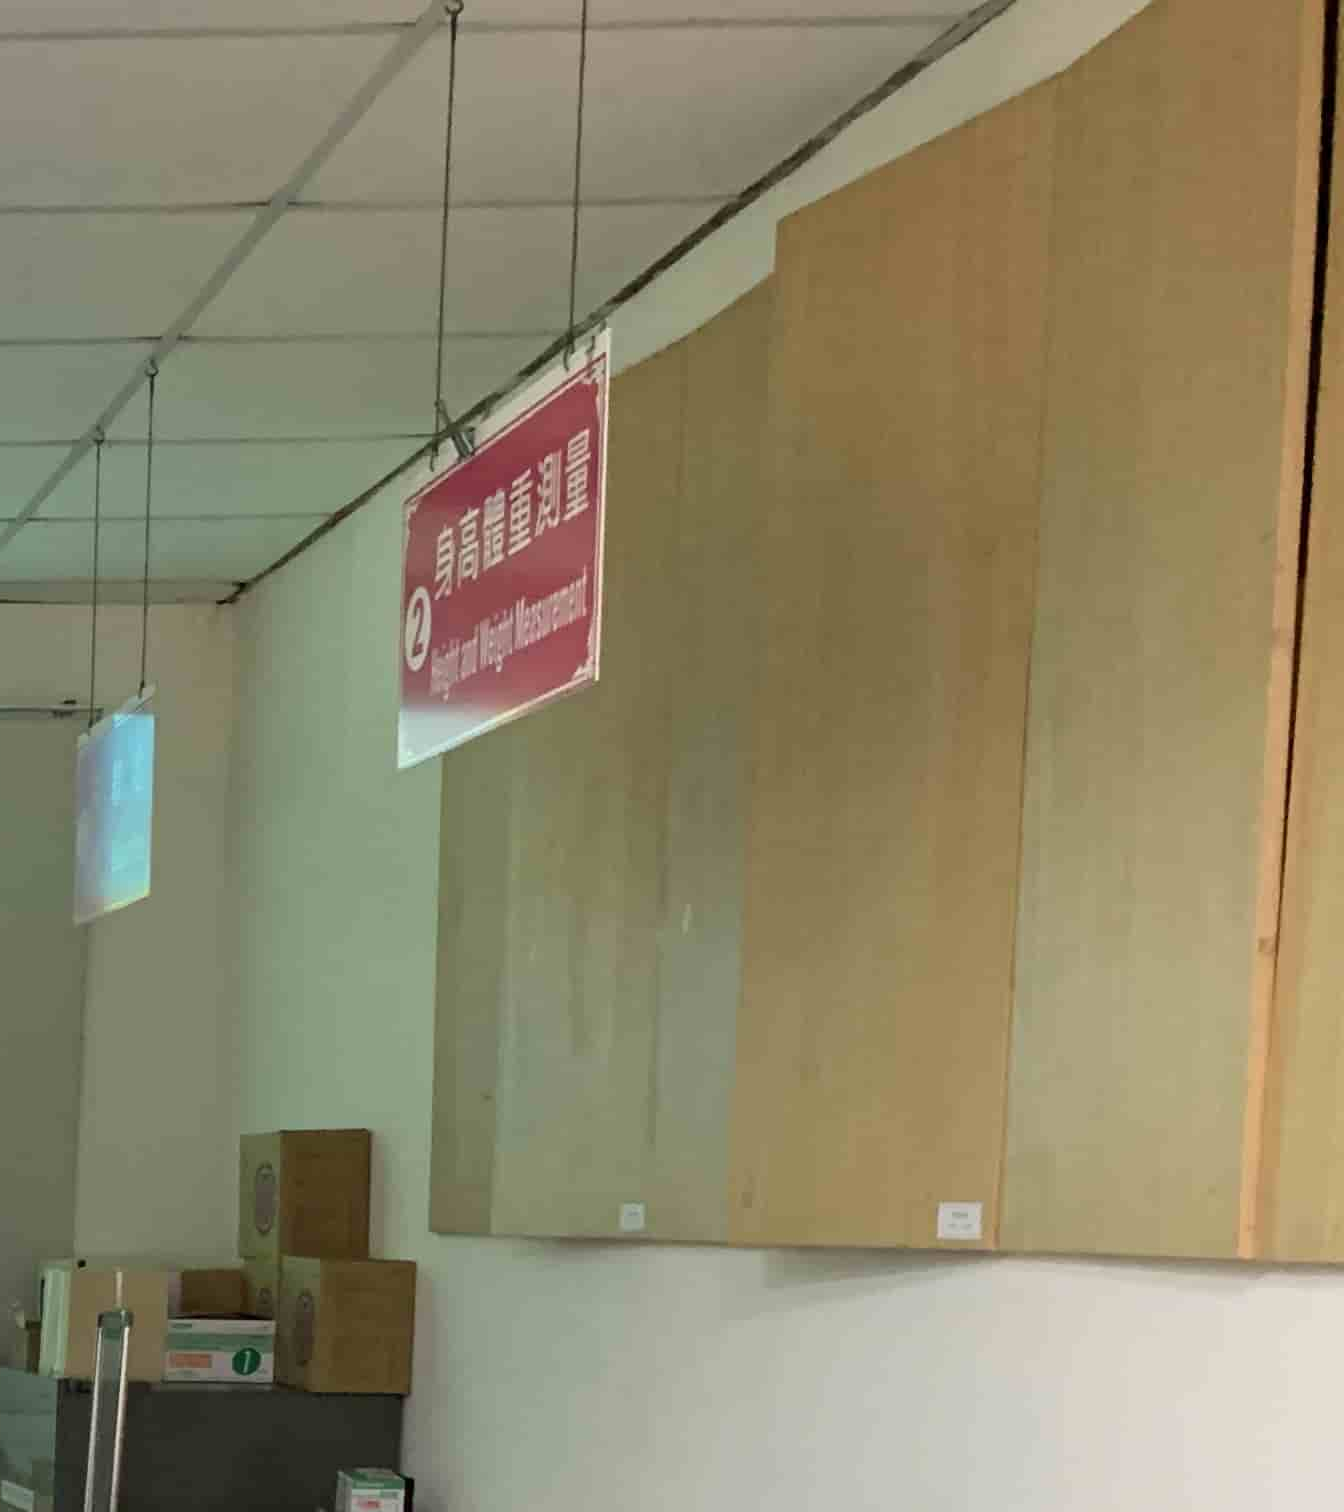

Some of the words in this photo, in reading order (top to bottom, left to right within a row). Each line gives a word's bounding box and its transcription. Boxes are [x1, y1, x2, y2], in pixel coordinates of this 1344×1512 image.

[435, 429, 591, 600] 身高體重測量
